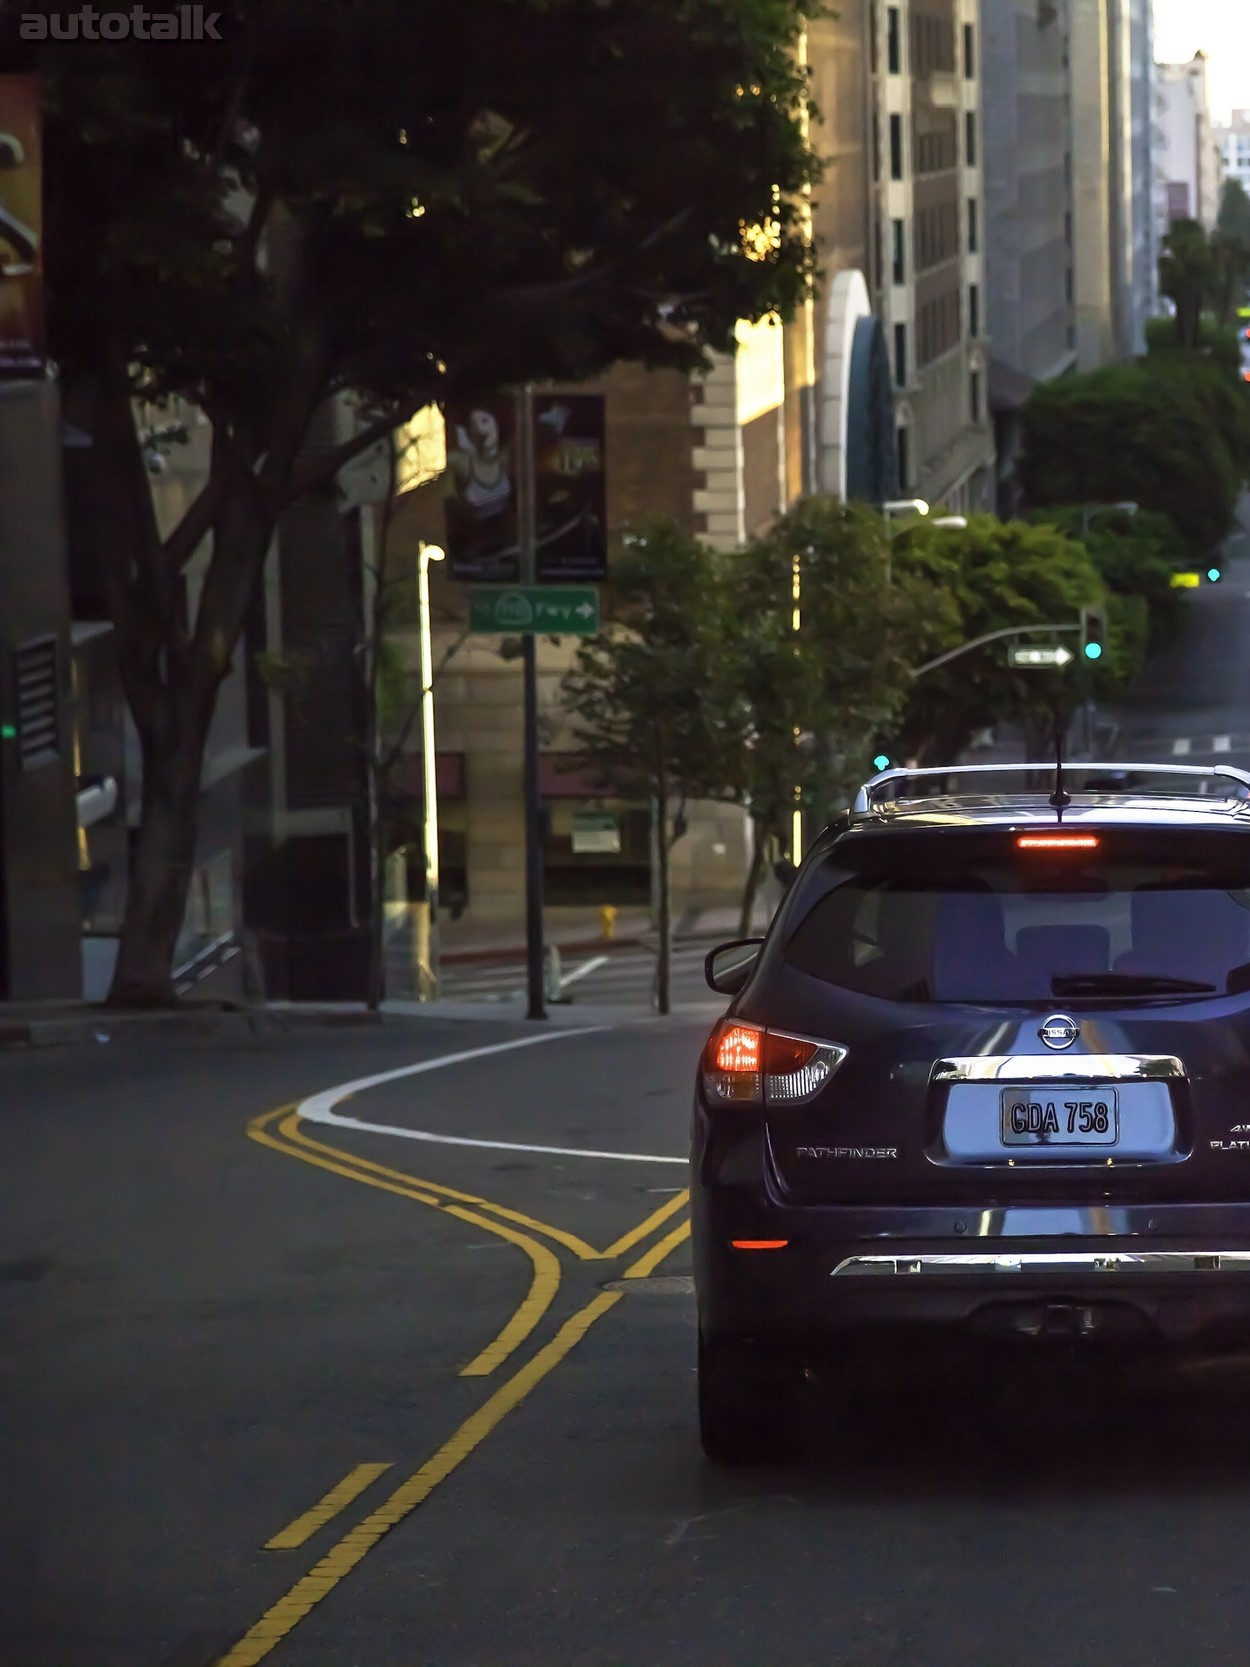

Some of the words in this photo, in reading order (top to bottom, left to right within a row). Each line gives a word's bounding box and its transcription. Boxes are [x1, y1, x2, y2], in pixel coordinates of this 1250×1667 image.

[1042, 1028, 1076, 1037] NISSAN
[1010, 1102, 1060, 1134] GDA
[1063, 1101, 1109, 1134] 758
[796, 1146, 898, 1159] PATHFINDER
